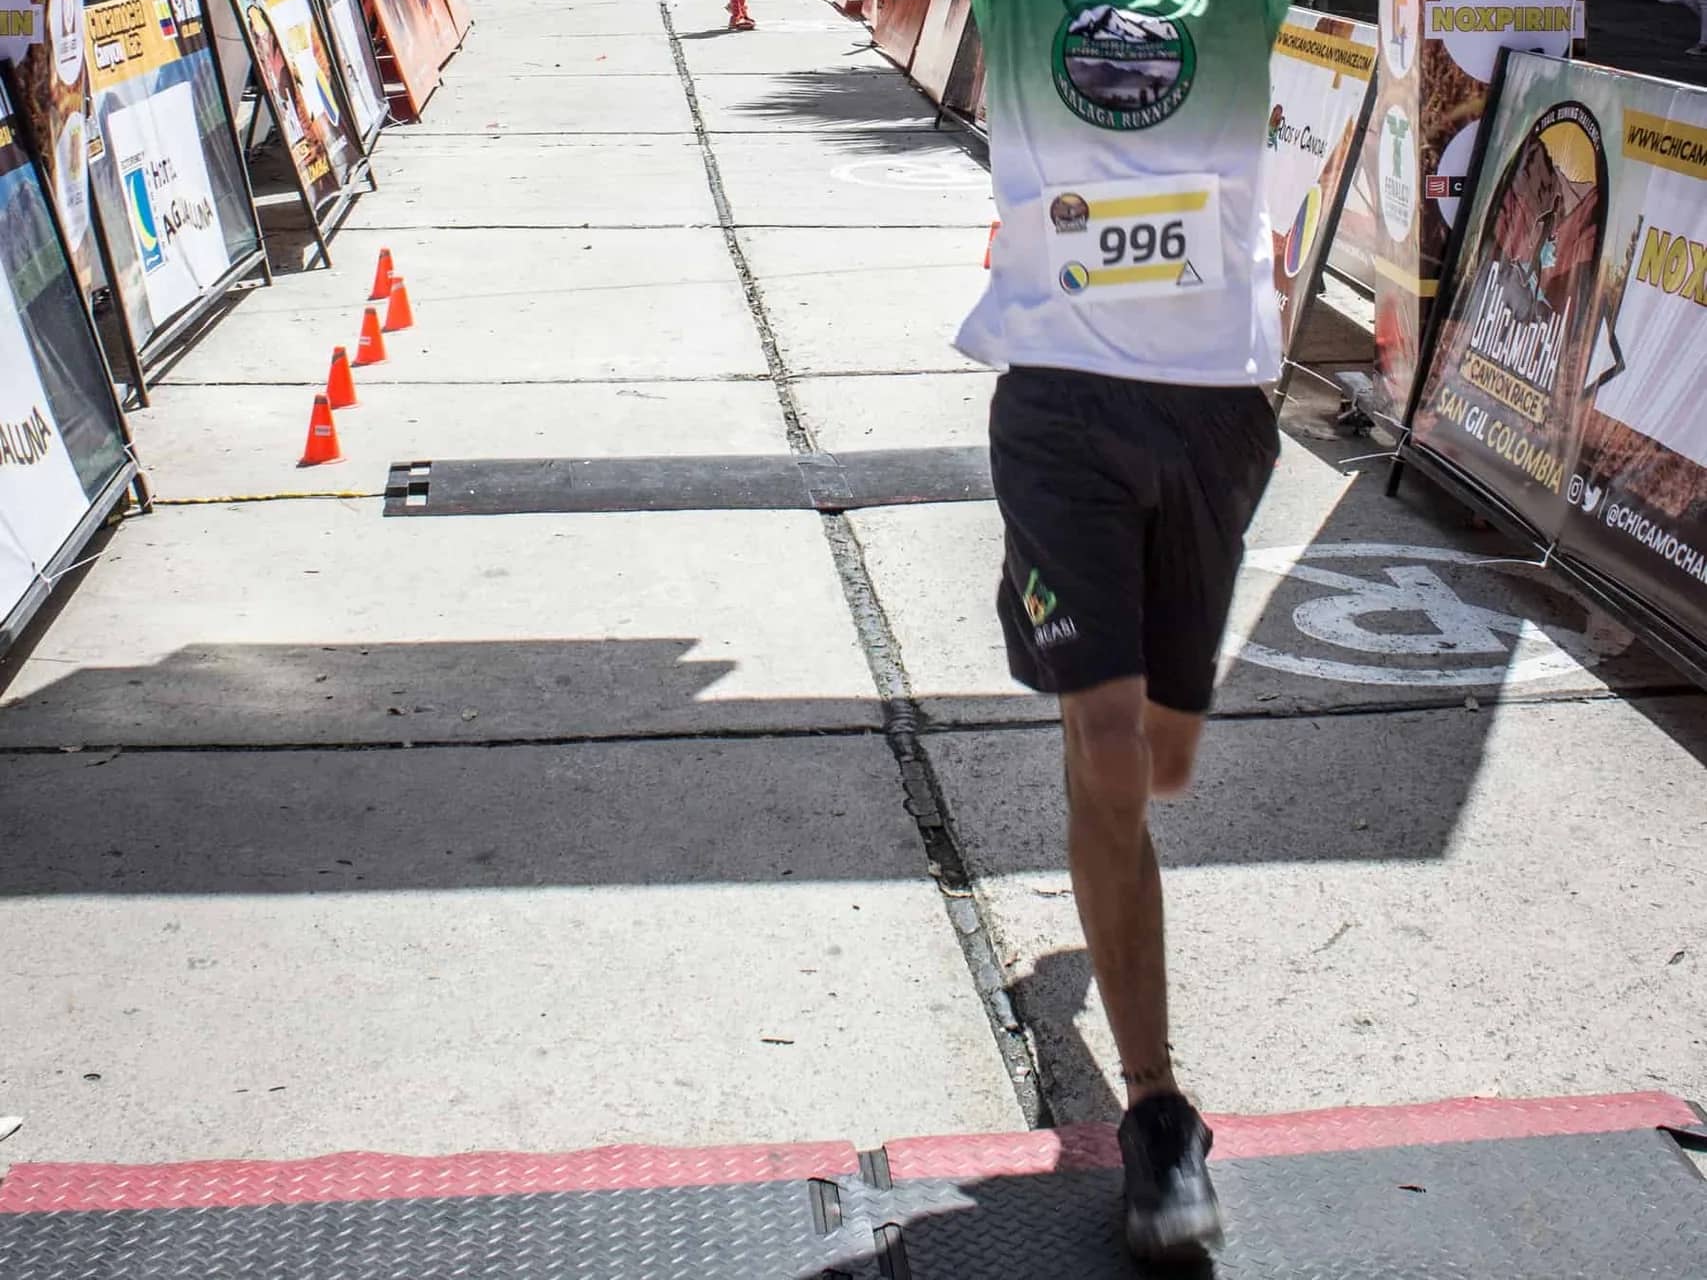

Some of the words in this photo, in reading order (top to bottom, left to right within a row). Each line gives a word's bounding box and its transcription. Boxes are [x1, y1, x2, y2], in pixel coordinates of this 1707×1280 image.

[1431, 5, 1577, 33] NOXPIRIN
[1100, 220, 1186, 266] 996
[1470, 261, 1572, 391] CHICAMOCHA
[1470, 360, 1511, 400] CANYON
[1510, 381, 1541, 417] RACE
[1436, 387, 1468, 426] SAN
[1464, 405, 1487, 441] GIL
[1486, 419, 1567, 495] COLOMBIA
